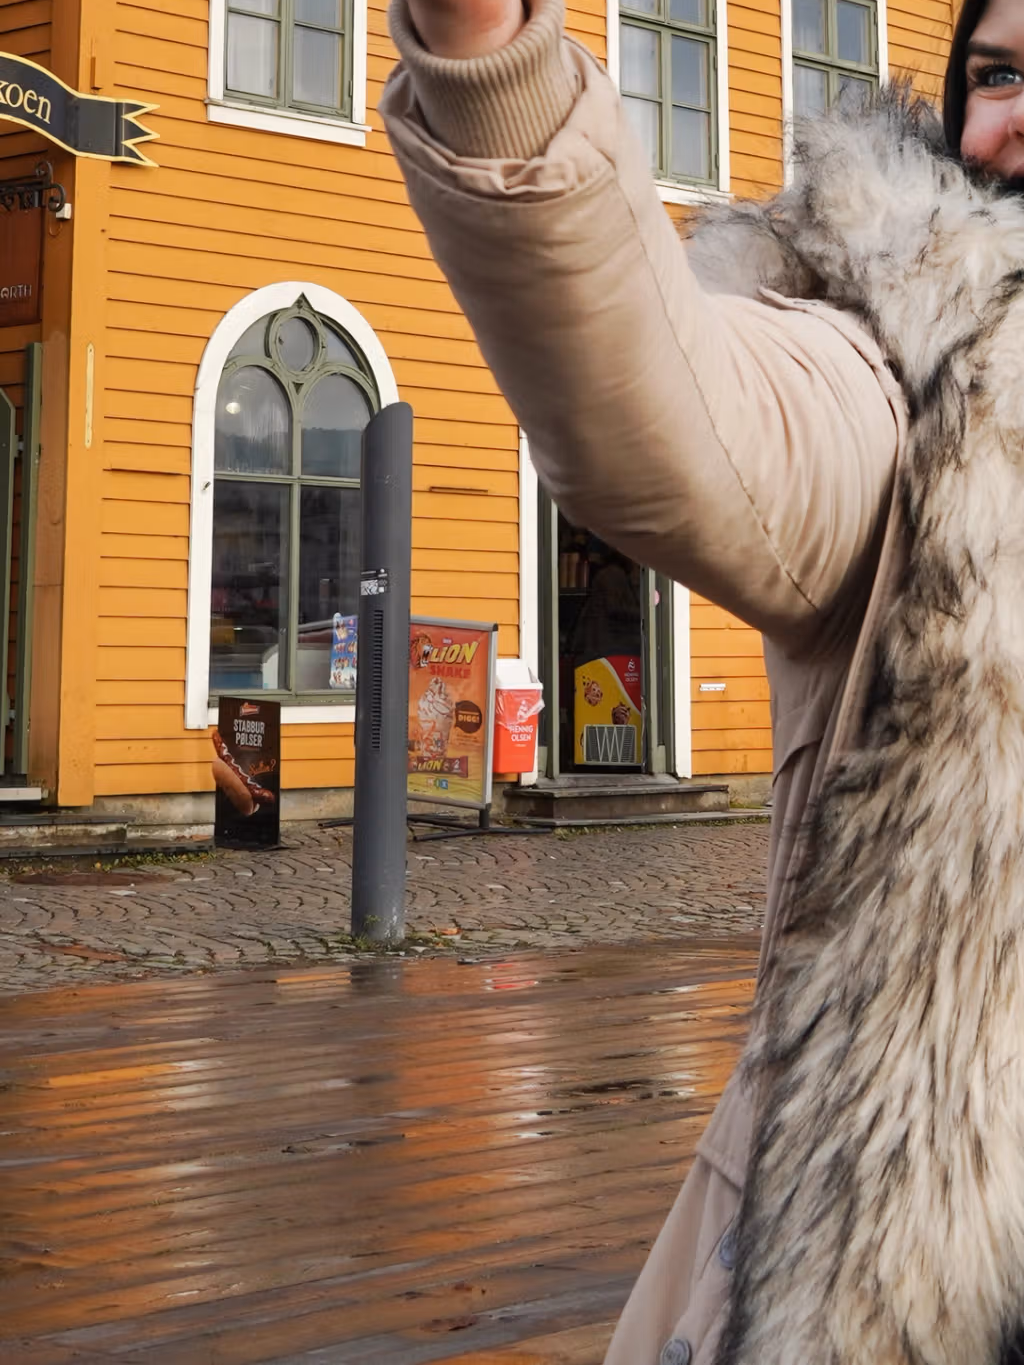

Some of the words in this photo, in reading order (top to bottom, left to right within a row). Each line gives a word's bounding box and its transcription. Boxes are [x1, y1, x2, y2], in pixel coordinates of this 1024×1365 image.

[429, 641, 479, 664] LION
[430, 665, 472, 679] SHAKE
[233, 719, 265, 734] STABBUR
[510, 725, 533, 733] HENNIG
[417, 759, 444, 772] LION
